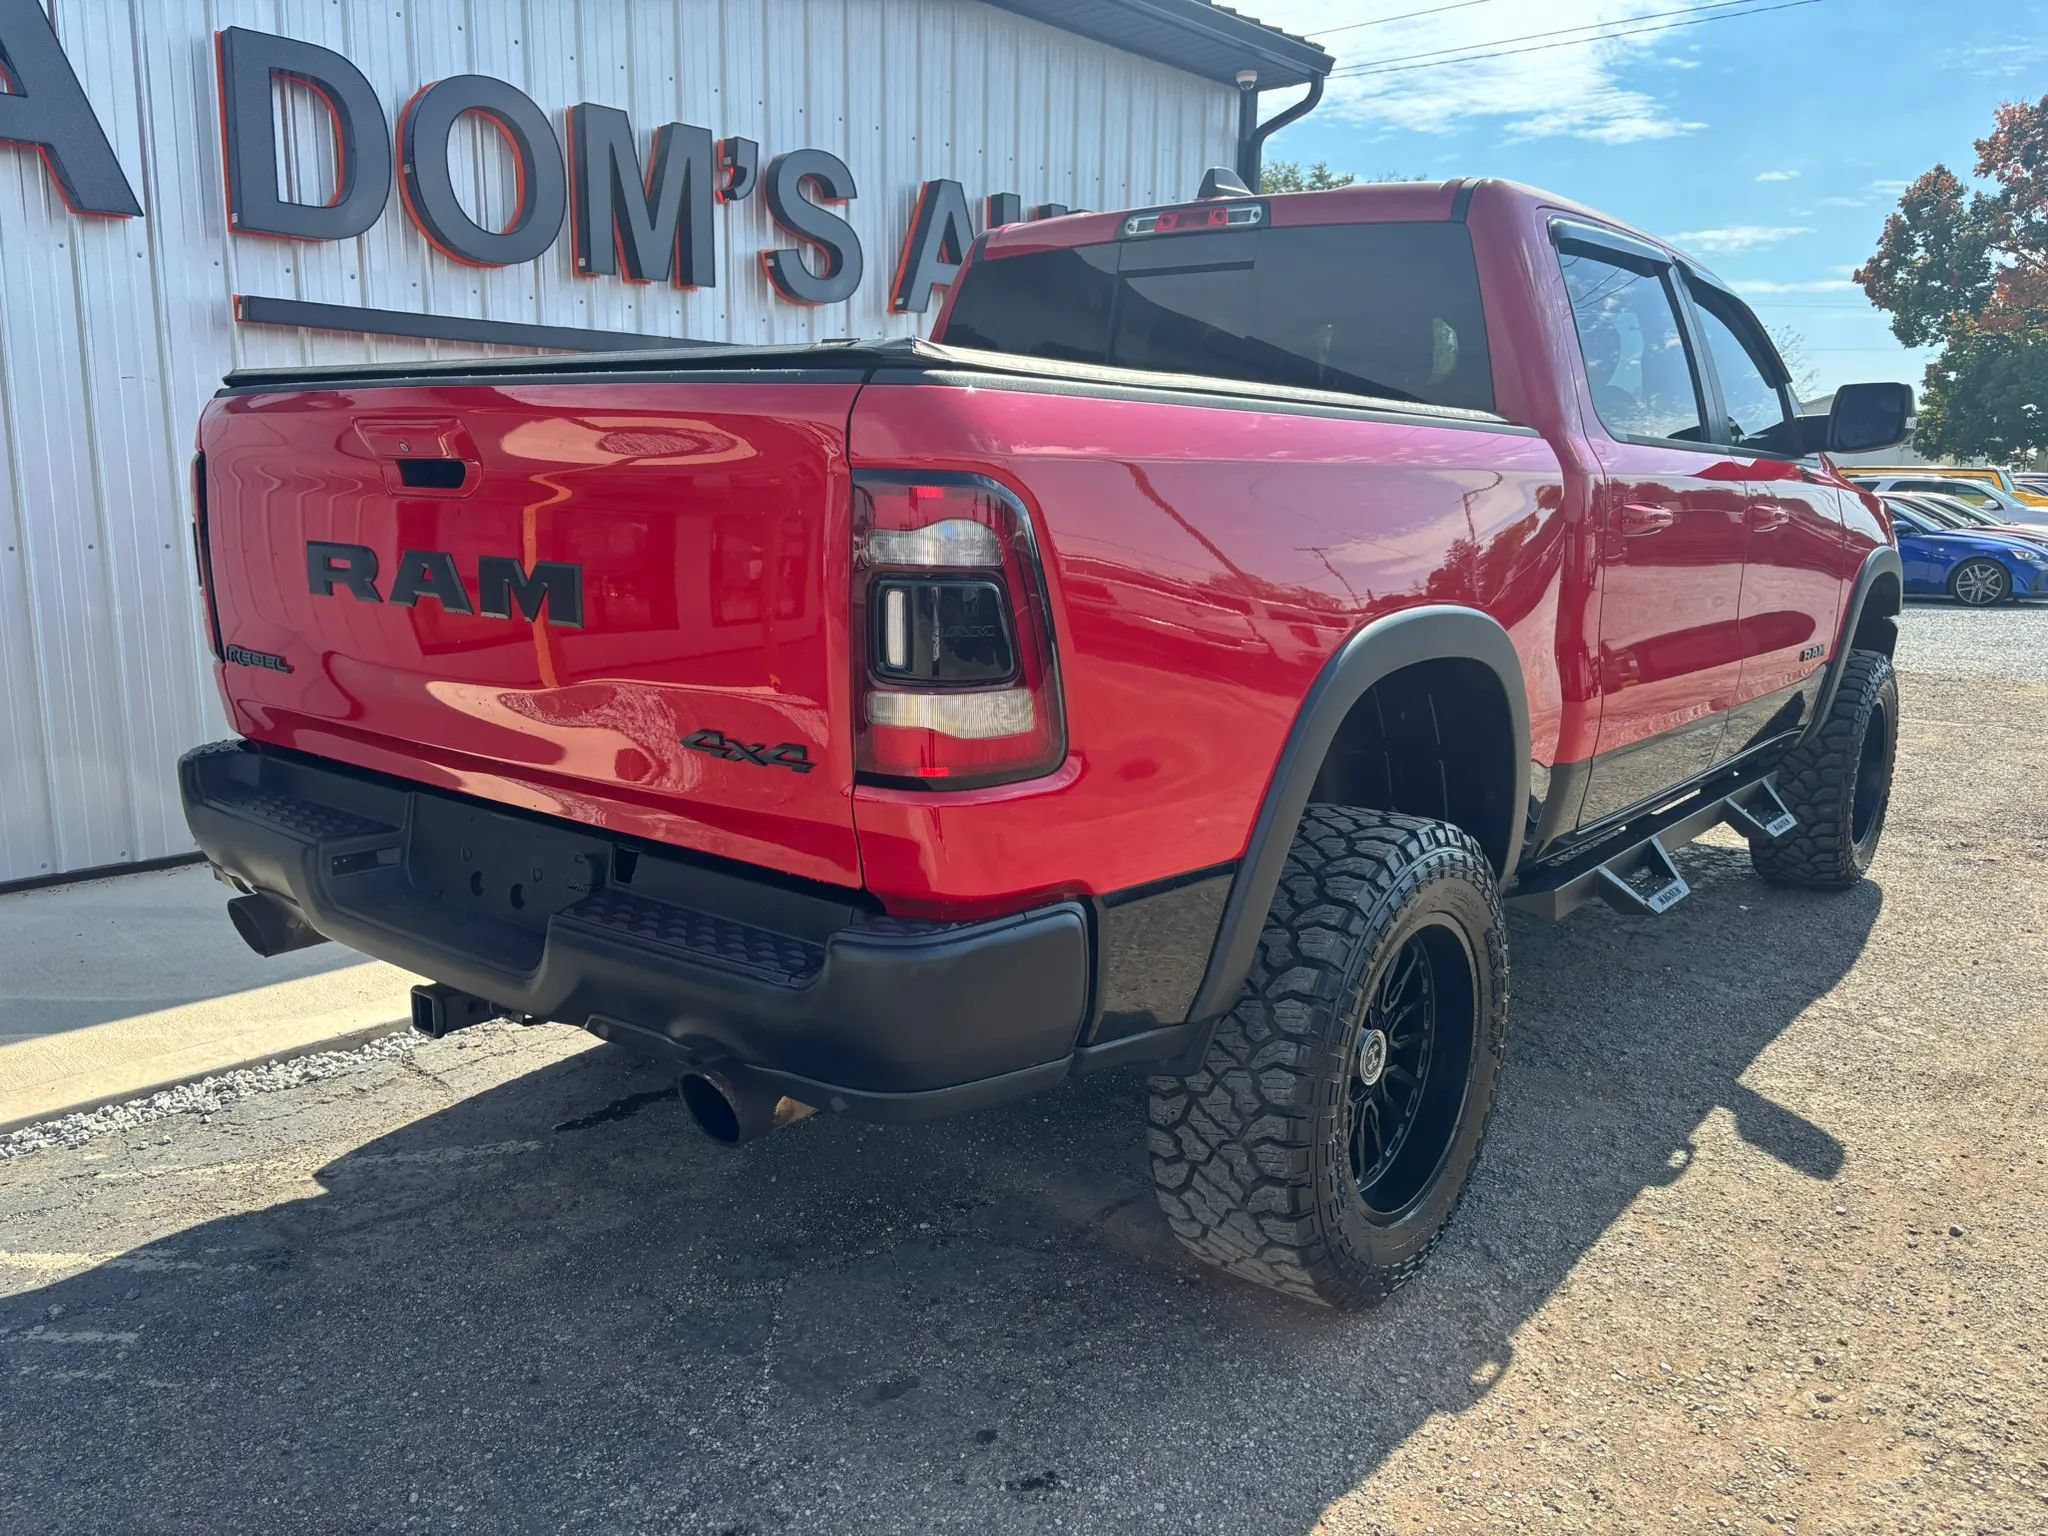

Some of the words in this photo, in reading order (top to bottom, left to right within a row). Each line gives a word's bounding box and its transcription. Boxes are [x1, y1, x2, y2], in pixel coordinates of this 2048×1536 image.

[214, 25, 864, 306] DOM'S
[306, 540, 584, 628] RAM
[226, 643, 295, 674] REBEL
